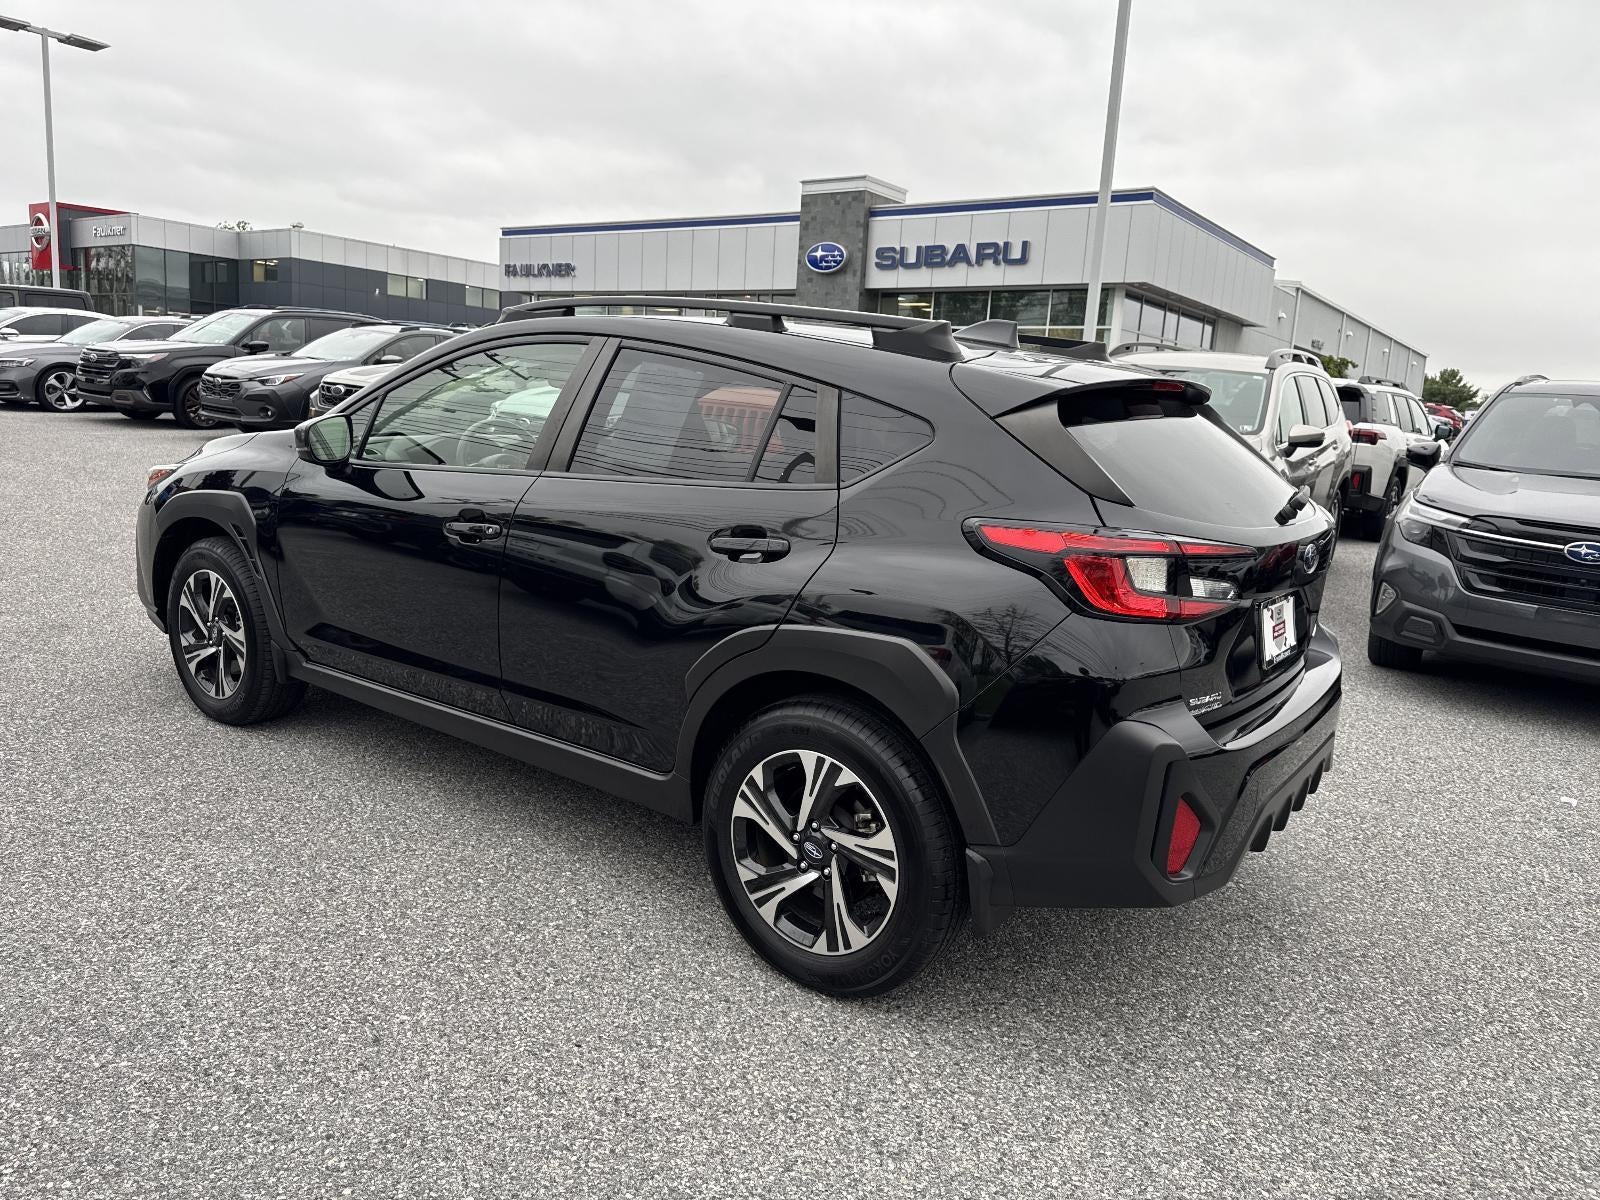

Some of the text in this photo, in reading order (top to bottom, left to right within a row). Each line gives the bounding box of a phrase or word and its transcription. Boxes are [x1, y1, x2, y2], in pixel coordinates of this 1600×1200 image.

[92, 224, 126, 238] Faulkner
[874, 240, 1030, 271] SUBARU
[504, 262, 576, 278] FAULKNER
